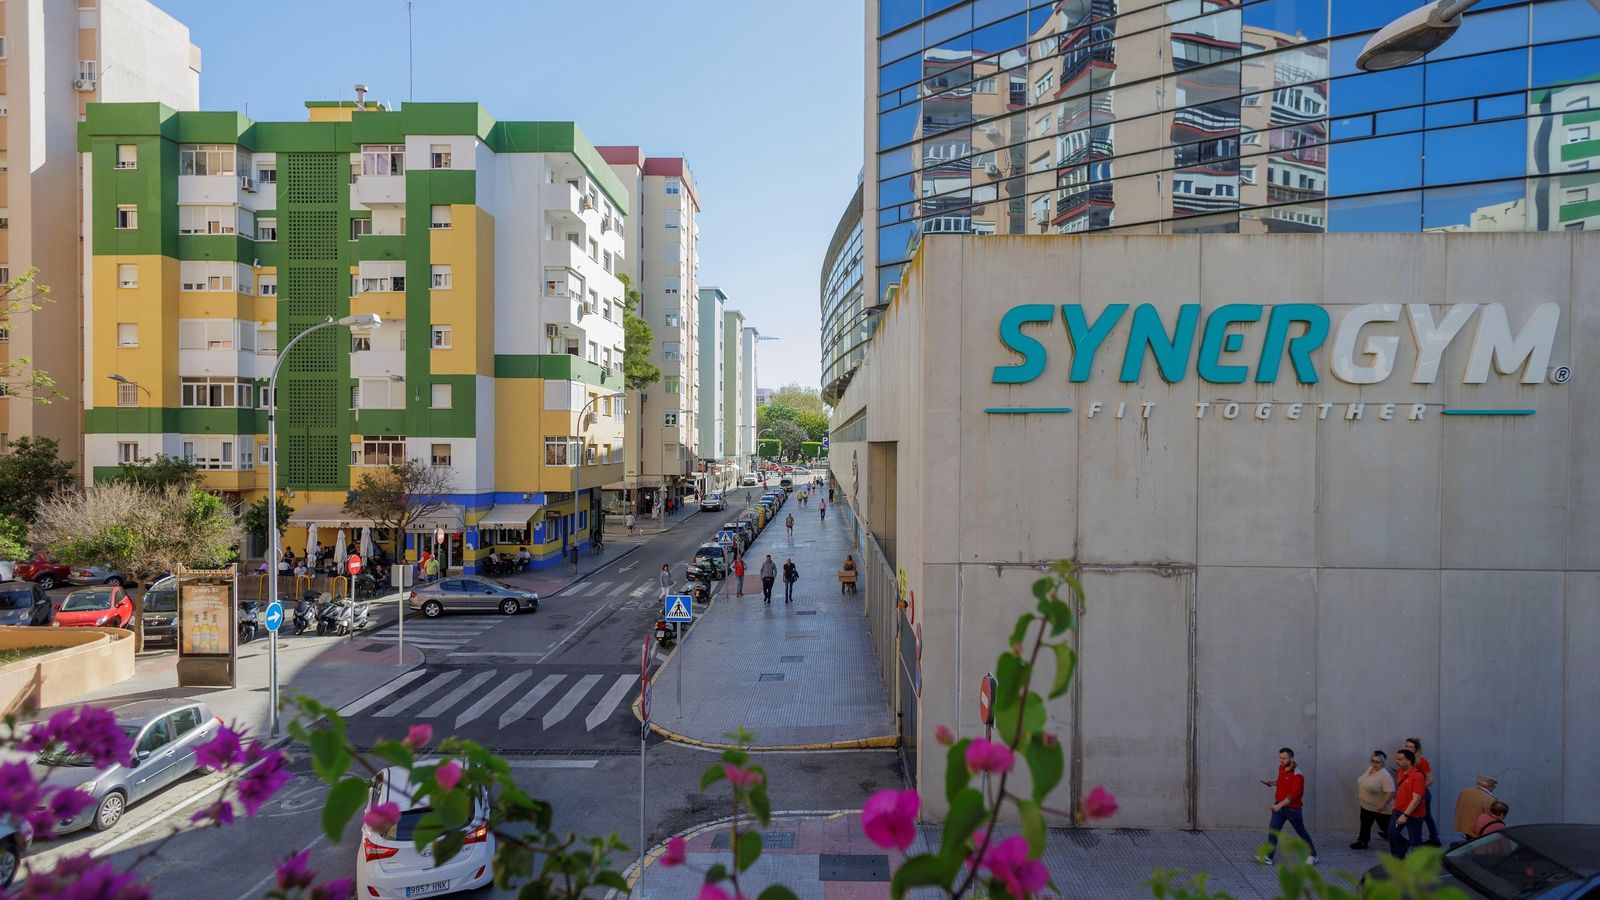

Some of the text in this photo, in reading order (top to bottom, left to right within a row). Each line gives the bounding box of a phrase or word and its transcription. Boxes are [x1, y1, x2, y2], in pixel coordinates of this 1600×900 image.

[991, 303, 1561, 385] SYNERGYM
[1088, 402, 1426, 420] FIT TOGETHER
[411, 884, 430, 894] 9957
